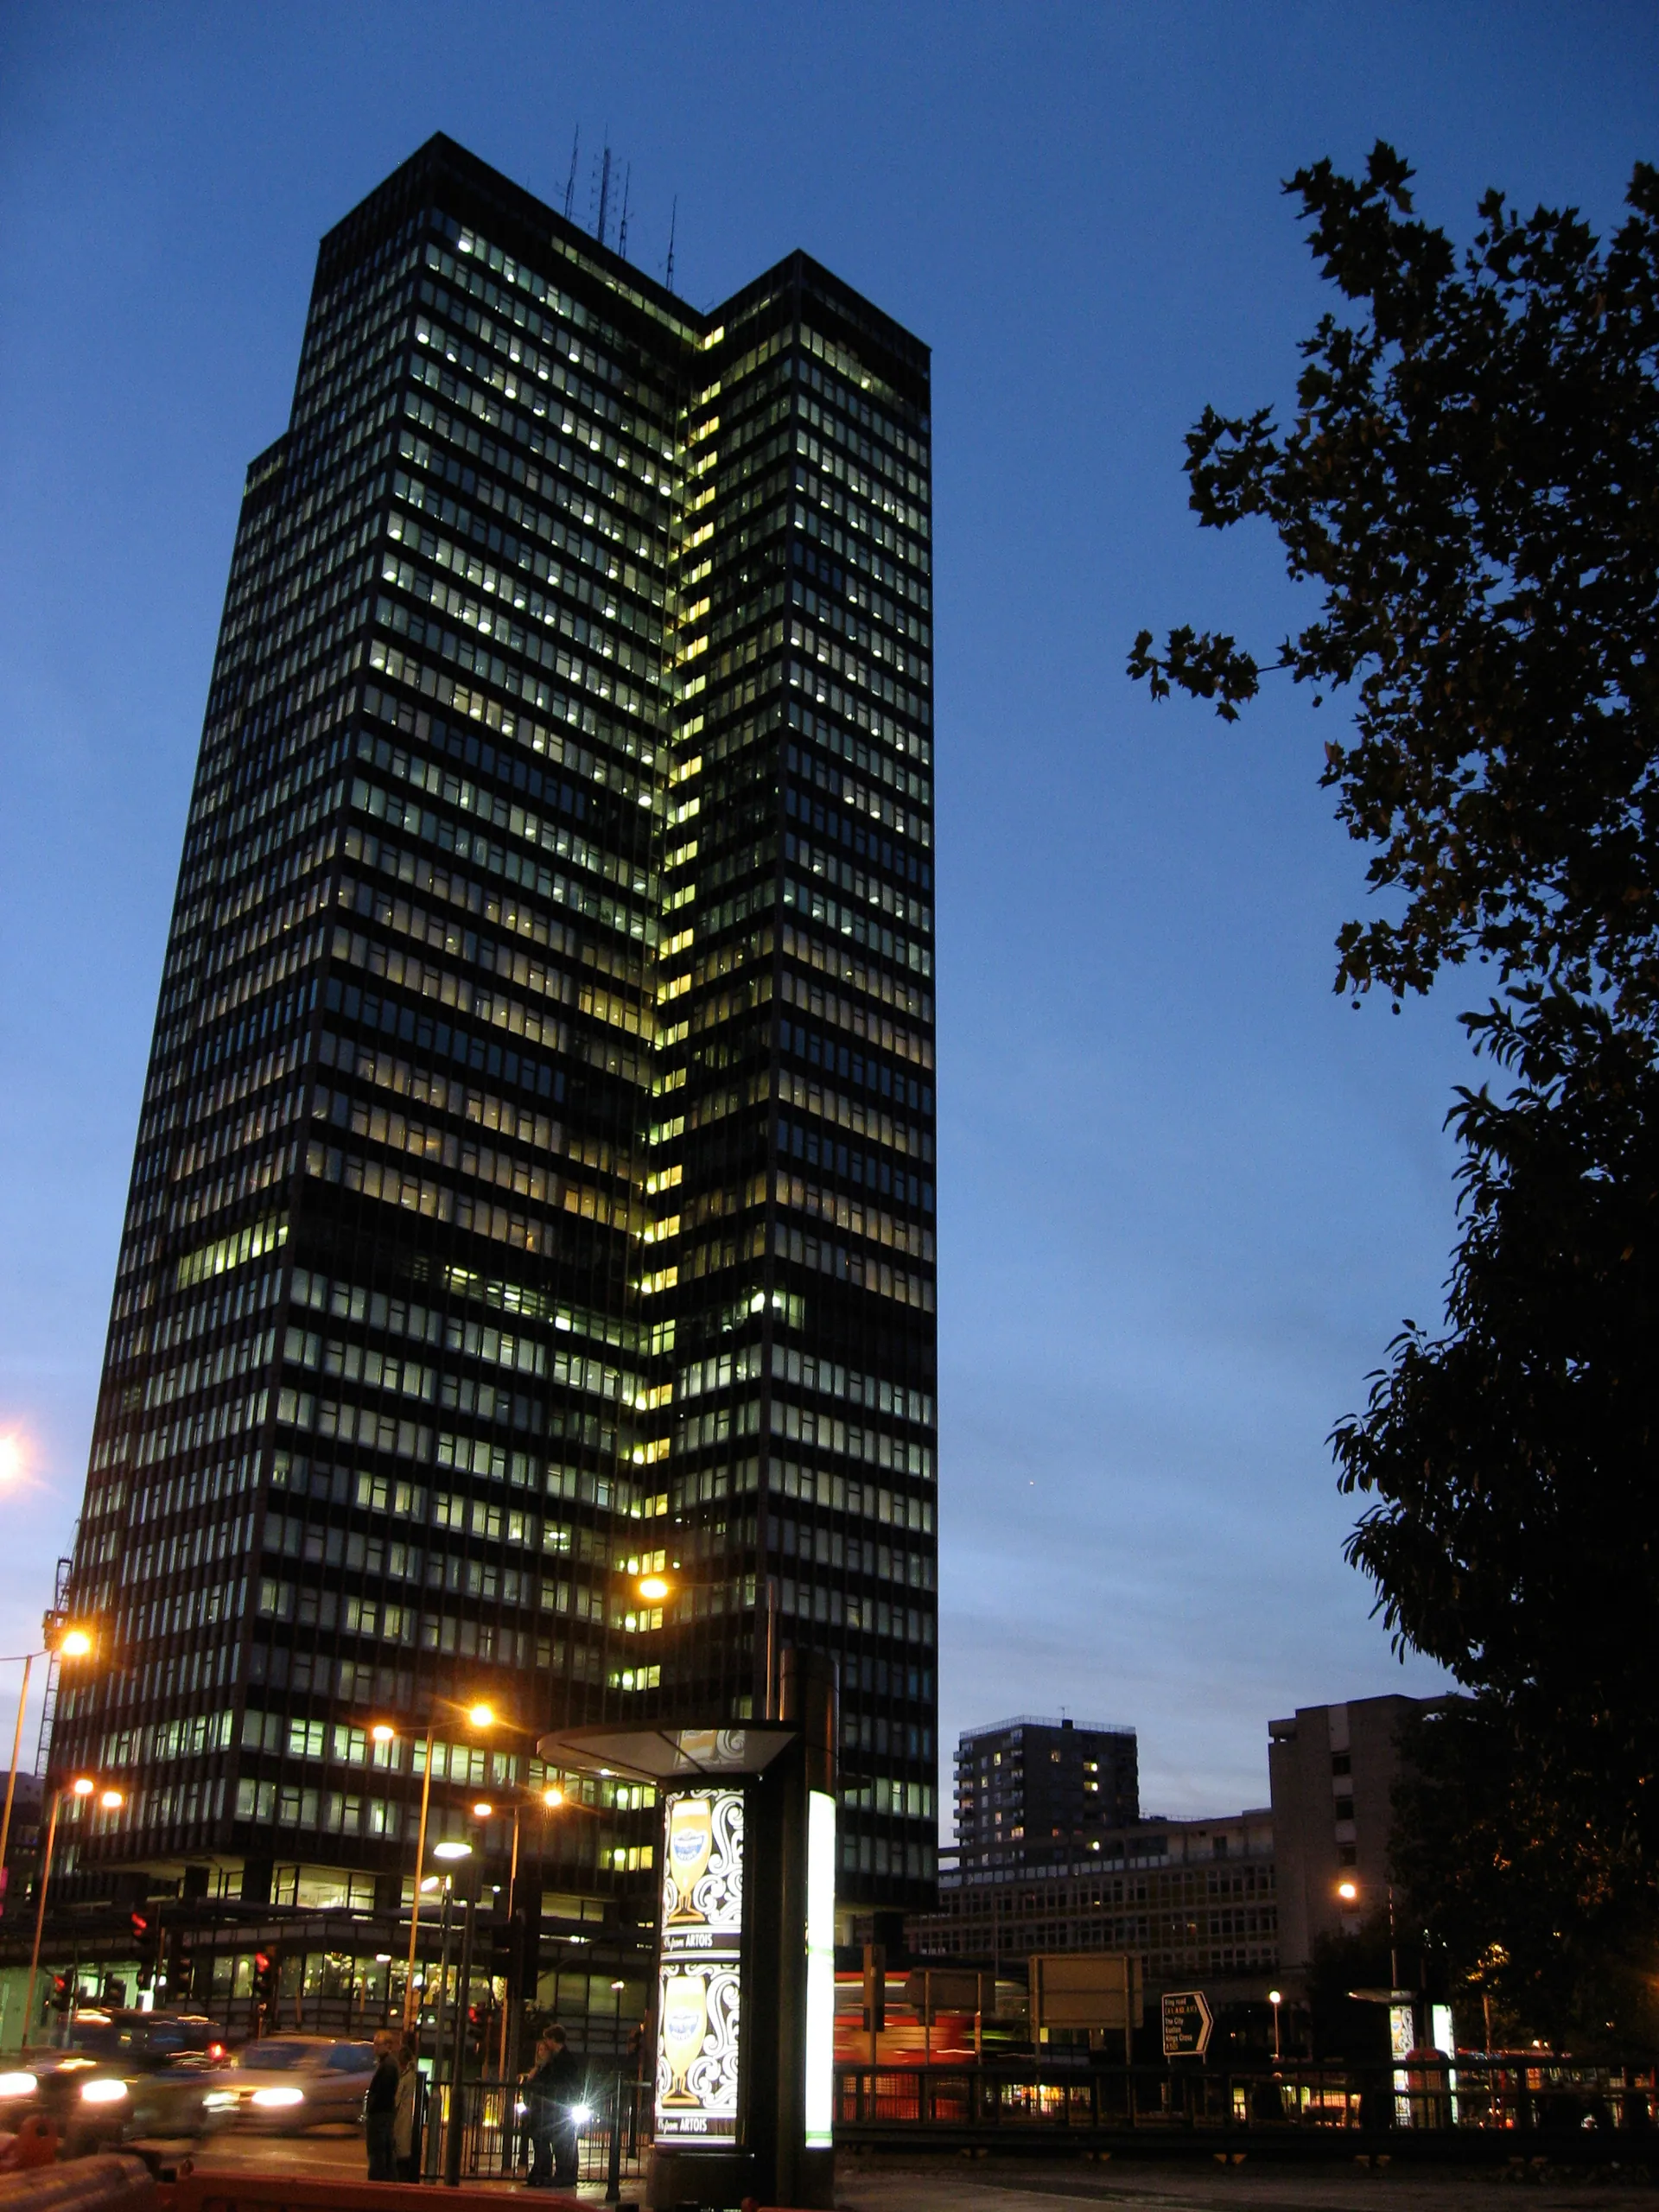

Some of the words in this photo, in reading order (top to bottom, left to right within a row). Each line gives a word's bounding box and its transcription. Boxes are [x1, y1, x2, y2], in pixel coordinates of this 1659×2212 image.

[685, 1933, 713, 1948] ARTOIS
[1174, 2017, 1184, 2025] City
[1179, 2033, 1192, 2042] Cross
[680, 2118, 708, 2133] ARTOIS
